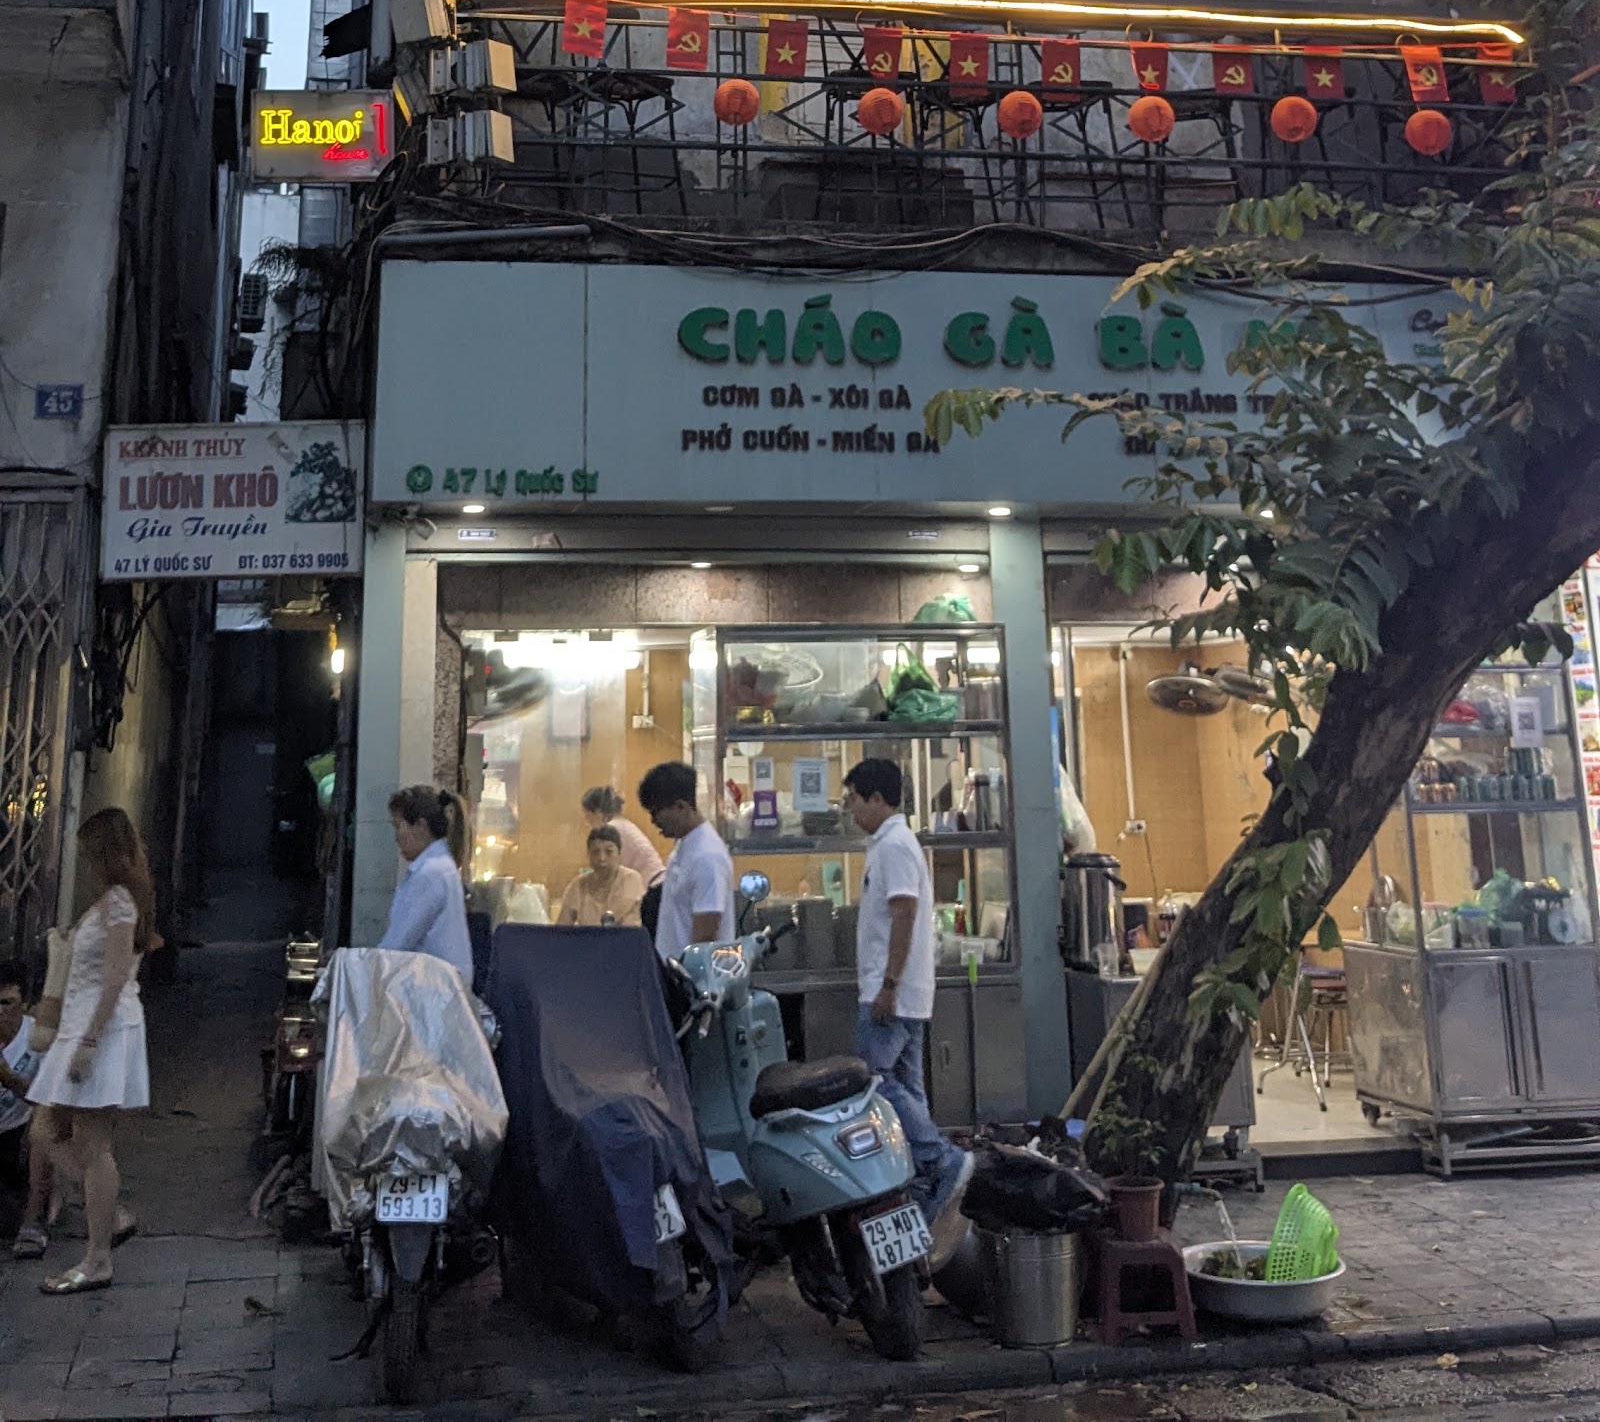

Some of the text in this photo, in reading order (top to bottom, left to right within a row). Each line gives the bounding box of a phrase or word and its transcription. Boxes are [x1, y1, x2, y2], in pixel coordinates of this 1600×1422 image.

[260, 109, 364, 145] Hanoi
[677, 293, 901, 365] CHÁO
[942, 294, 1055, 369] GÀ
[1099, 301, 1205, 371] BÀ
[702, 384, 760, 409] CƠM
[770, 382, 804, 409] GÀ
[828, 384, 869, 410] XÔI
[878, 384, 911, 410] GÀ
[681, 422, 732, 453] PHỞ
[742, 424, 809, 453] CUỐN
[832, 424, 895, 453] MIẾN
[119, 465, 279, 511] LƯƠN KHÔ
[442, 467, 478, 494] 47
[126, 514, 268, 543] Gia Truyền
[114, 559, 131, 573] 47
[135, 554, 150, 572] LÝ
[154, 552, 189, 572] QUỐC
[193, 554, 213, 571] SƯ
[262, 554, 286, 569] 037
[290, 553, 313, 569] 633
[382, 1196, 442, 1218] 593.13
[875, 1230, 930, 1268] 487.46
